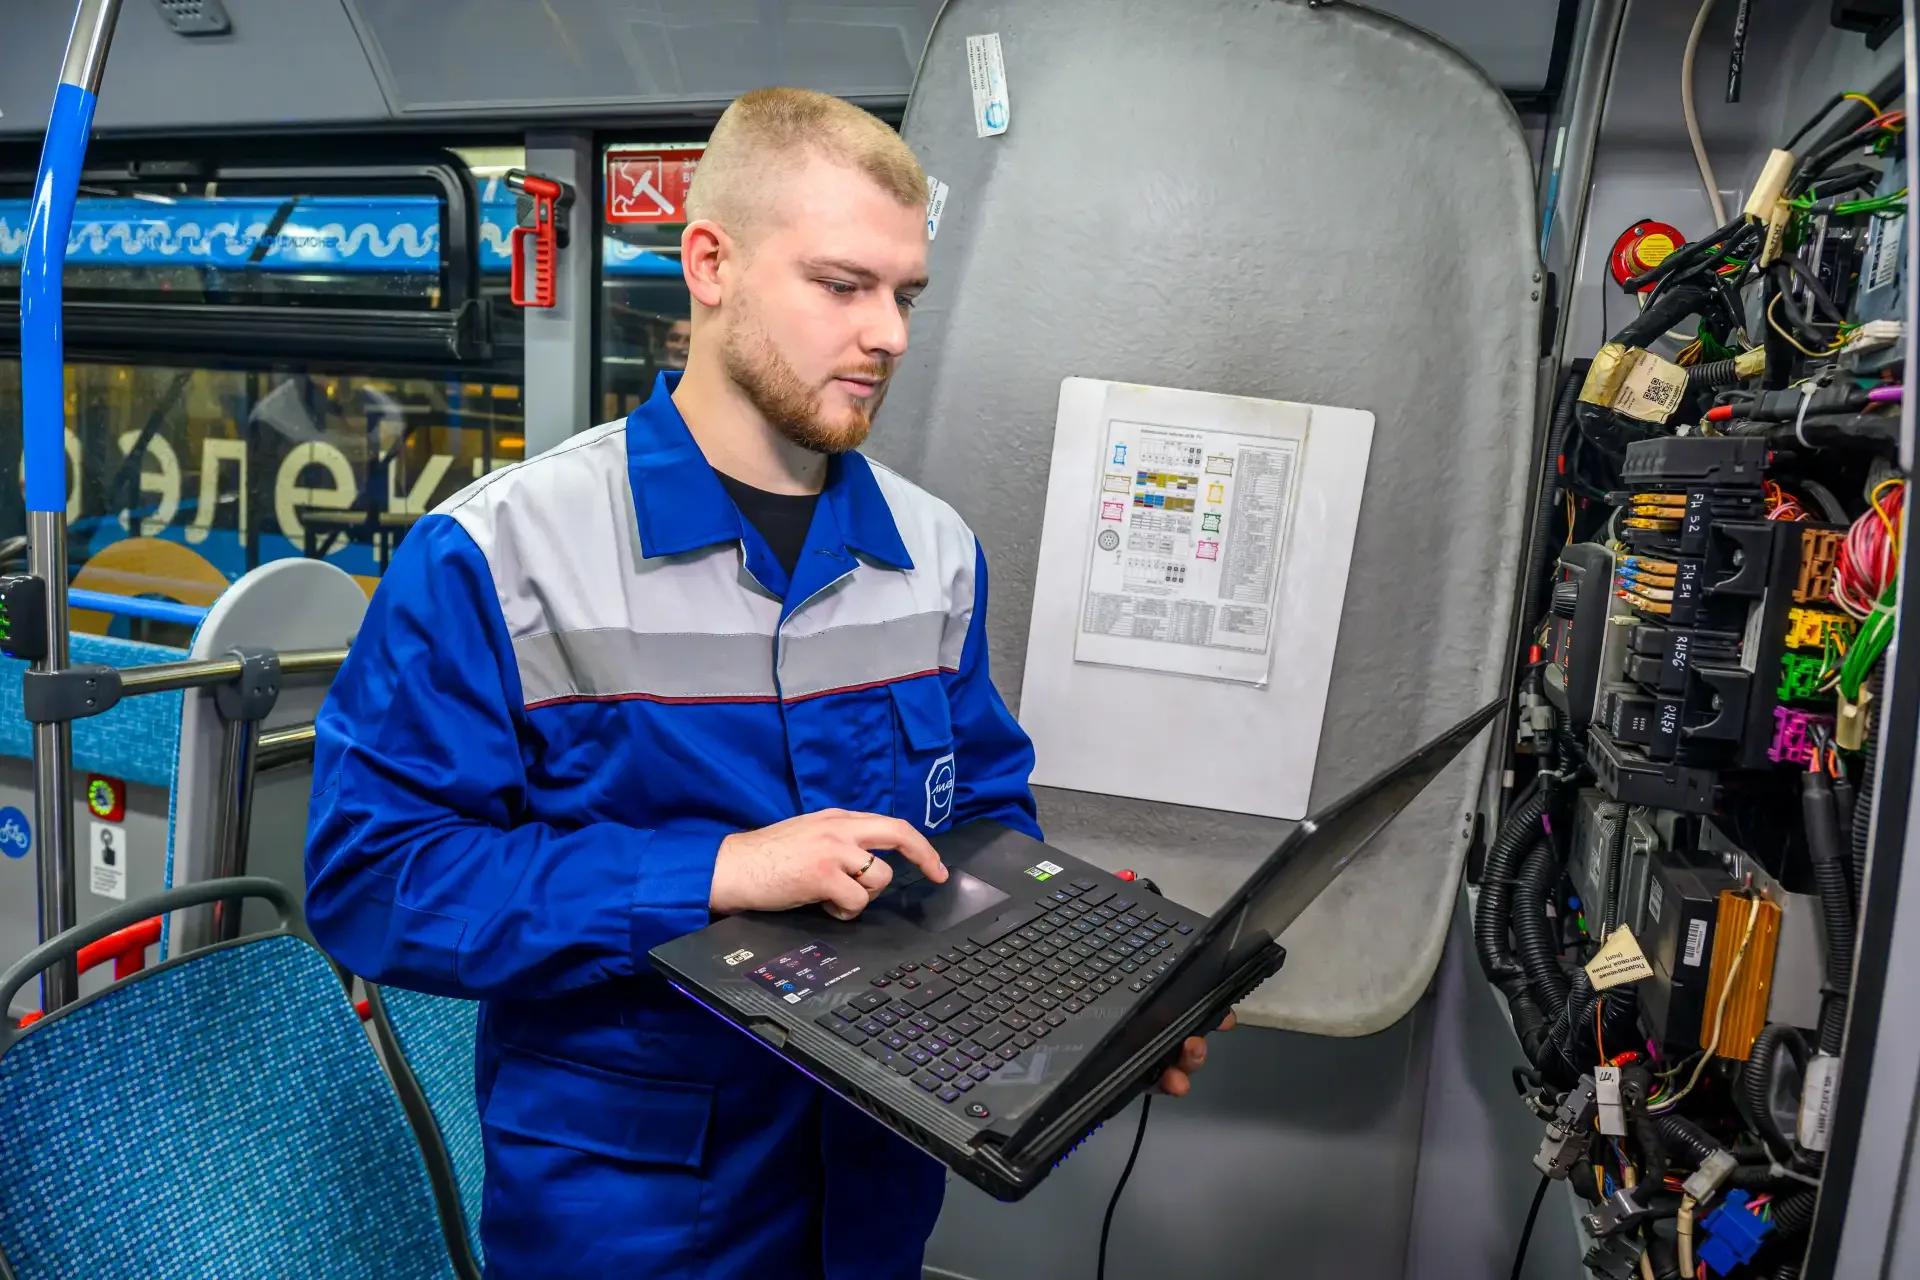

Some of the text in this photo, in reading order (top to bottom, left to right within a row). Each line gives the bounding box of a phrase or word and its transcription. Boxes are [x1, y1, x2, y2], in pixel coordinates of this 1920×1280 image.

[1591, 955, 1645, 974] световой линии
[1598, 962, 1646, 979] Подключение
